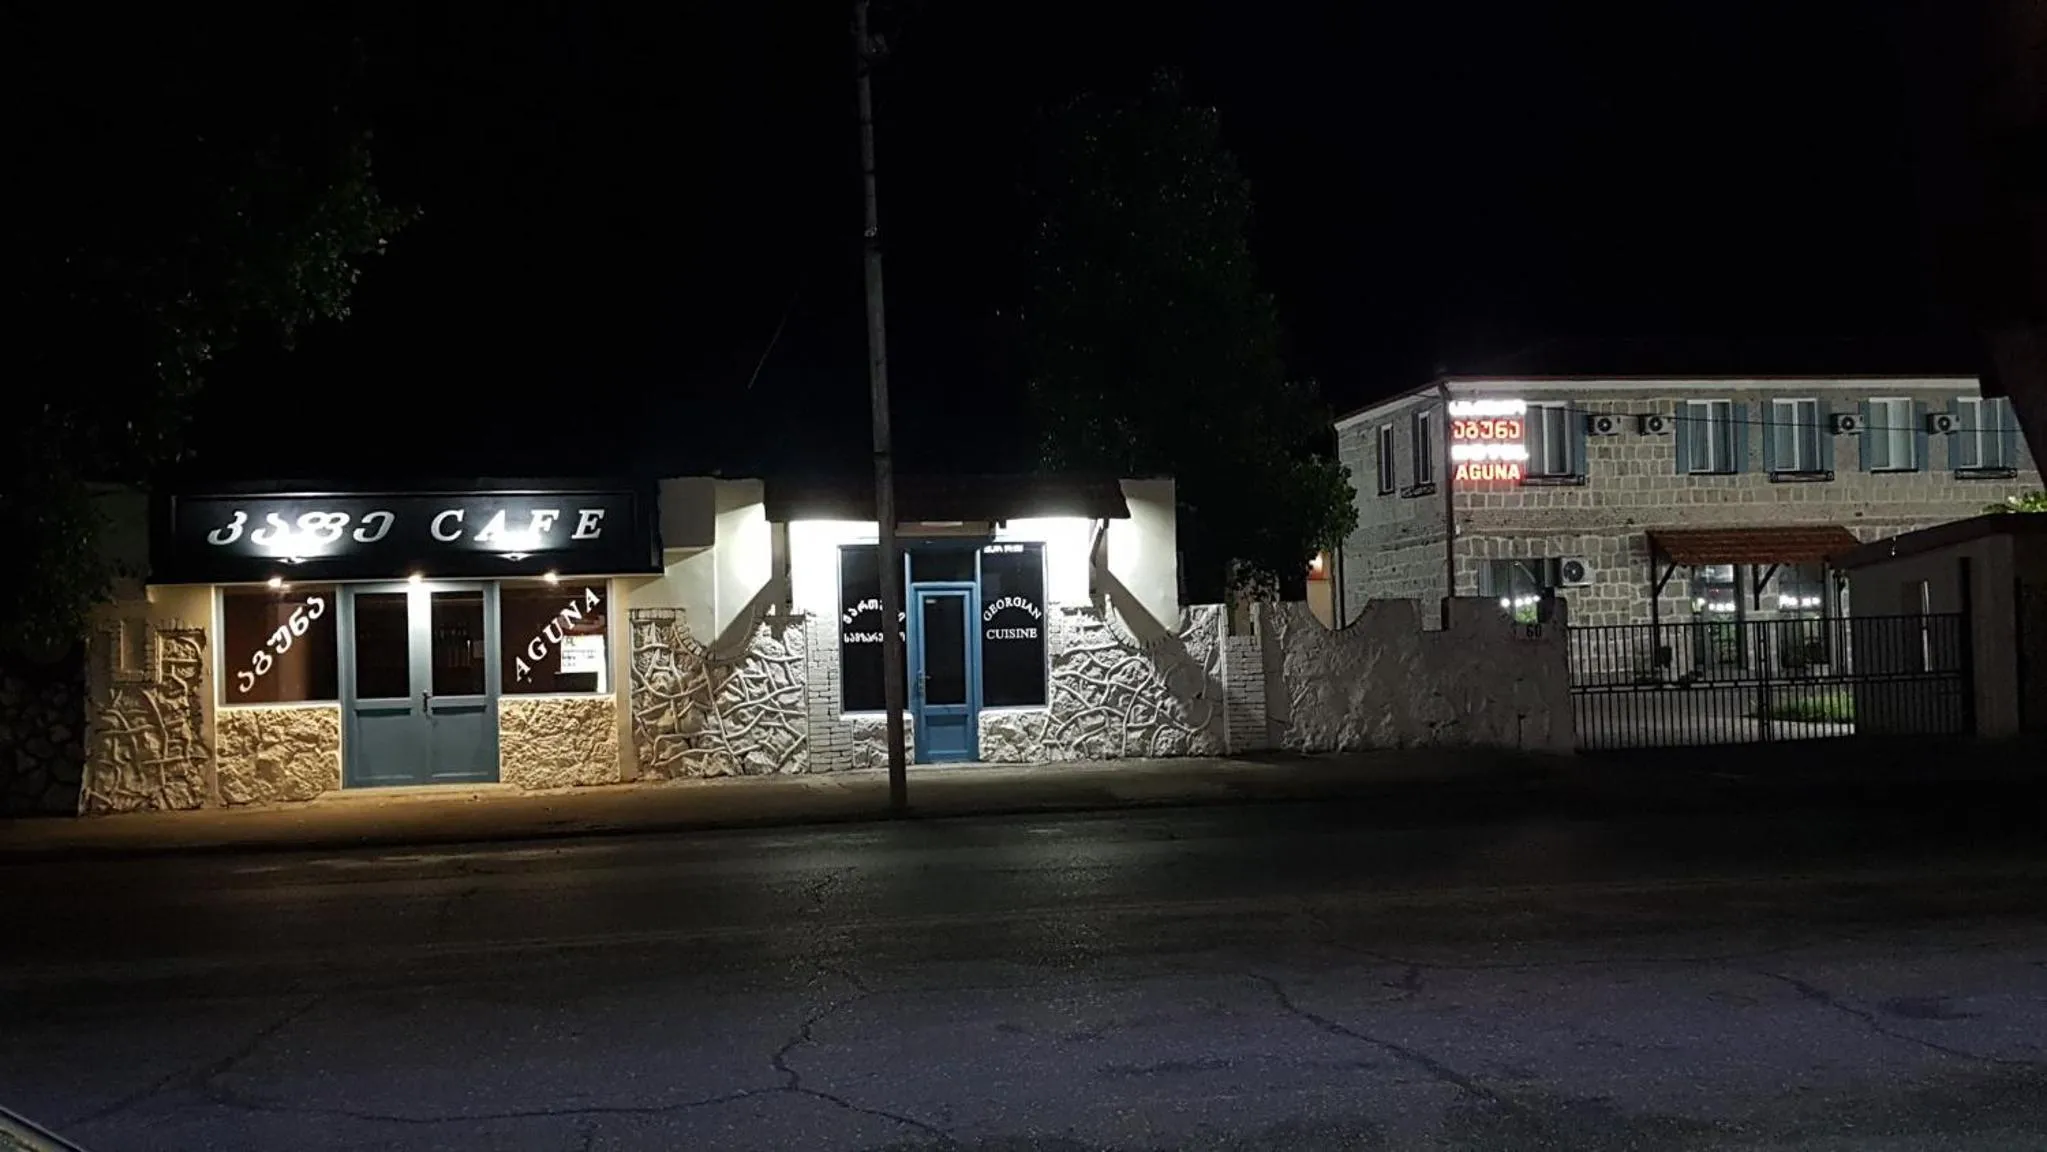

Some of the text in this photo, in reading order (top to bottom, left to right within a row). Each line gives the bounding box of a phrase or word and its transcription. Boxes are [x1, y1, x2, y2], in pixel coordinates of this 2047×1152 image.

[1455, 463, 1521, 481] AGUNA
[207, 509, 605, 545] კაფე CAFE
[983, 596, 1042, 621] GEORGIAN
[237, 597, 325, 693] აგუნა
[515, 587, 601, 684] AGUNA
[986, 627, 1038, 640] CUISINE
